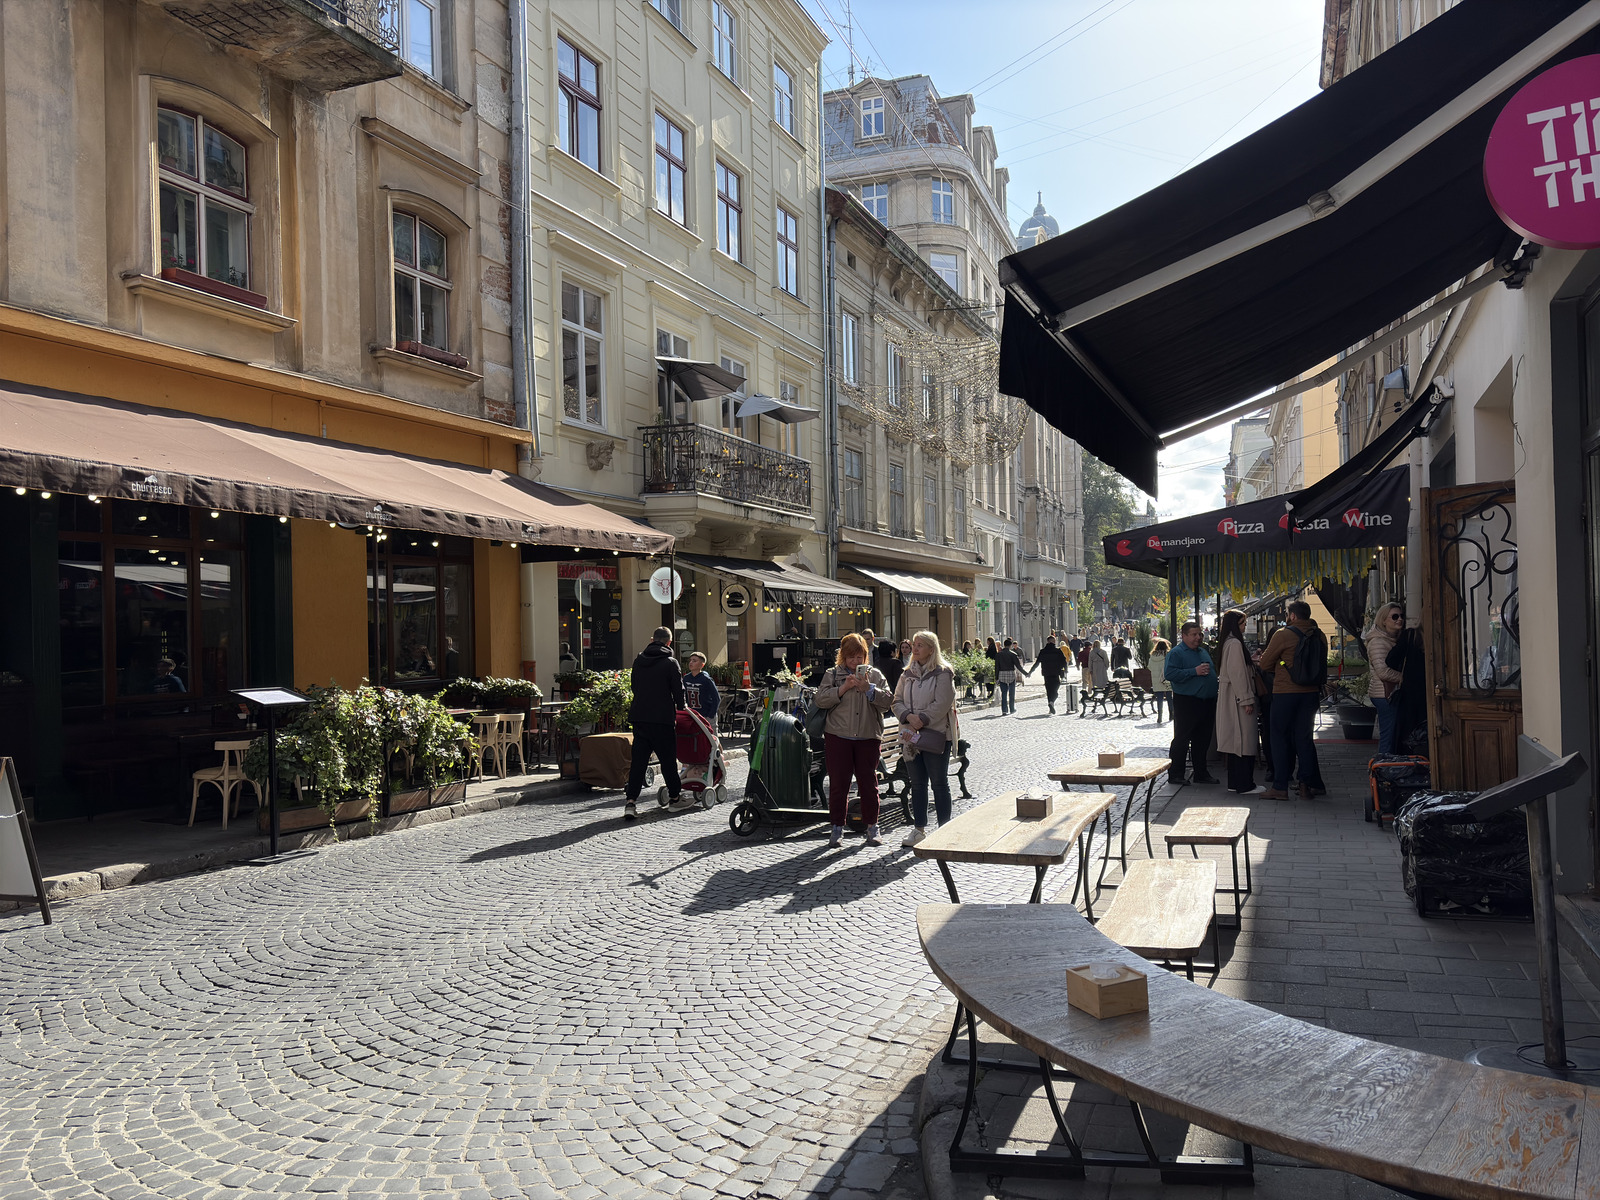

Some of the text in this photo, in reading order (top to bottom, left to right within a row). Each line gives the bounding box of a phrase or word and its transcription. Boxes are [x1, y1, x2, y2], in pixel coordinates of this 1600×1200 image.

[131, 481, 173, 495] churrasco
[1223, 520, 1265, 535] Pizza
[1343, 511, 1393, 528] Wine
[1148, 536, 1206, 548] Demandjaro
